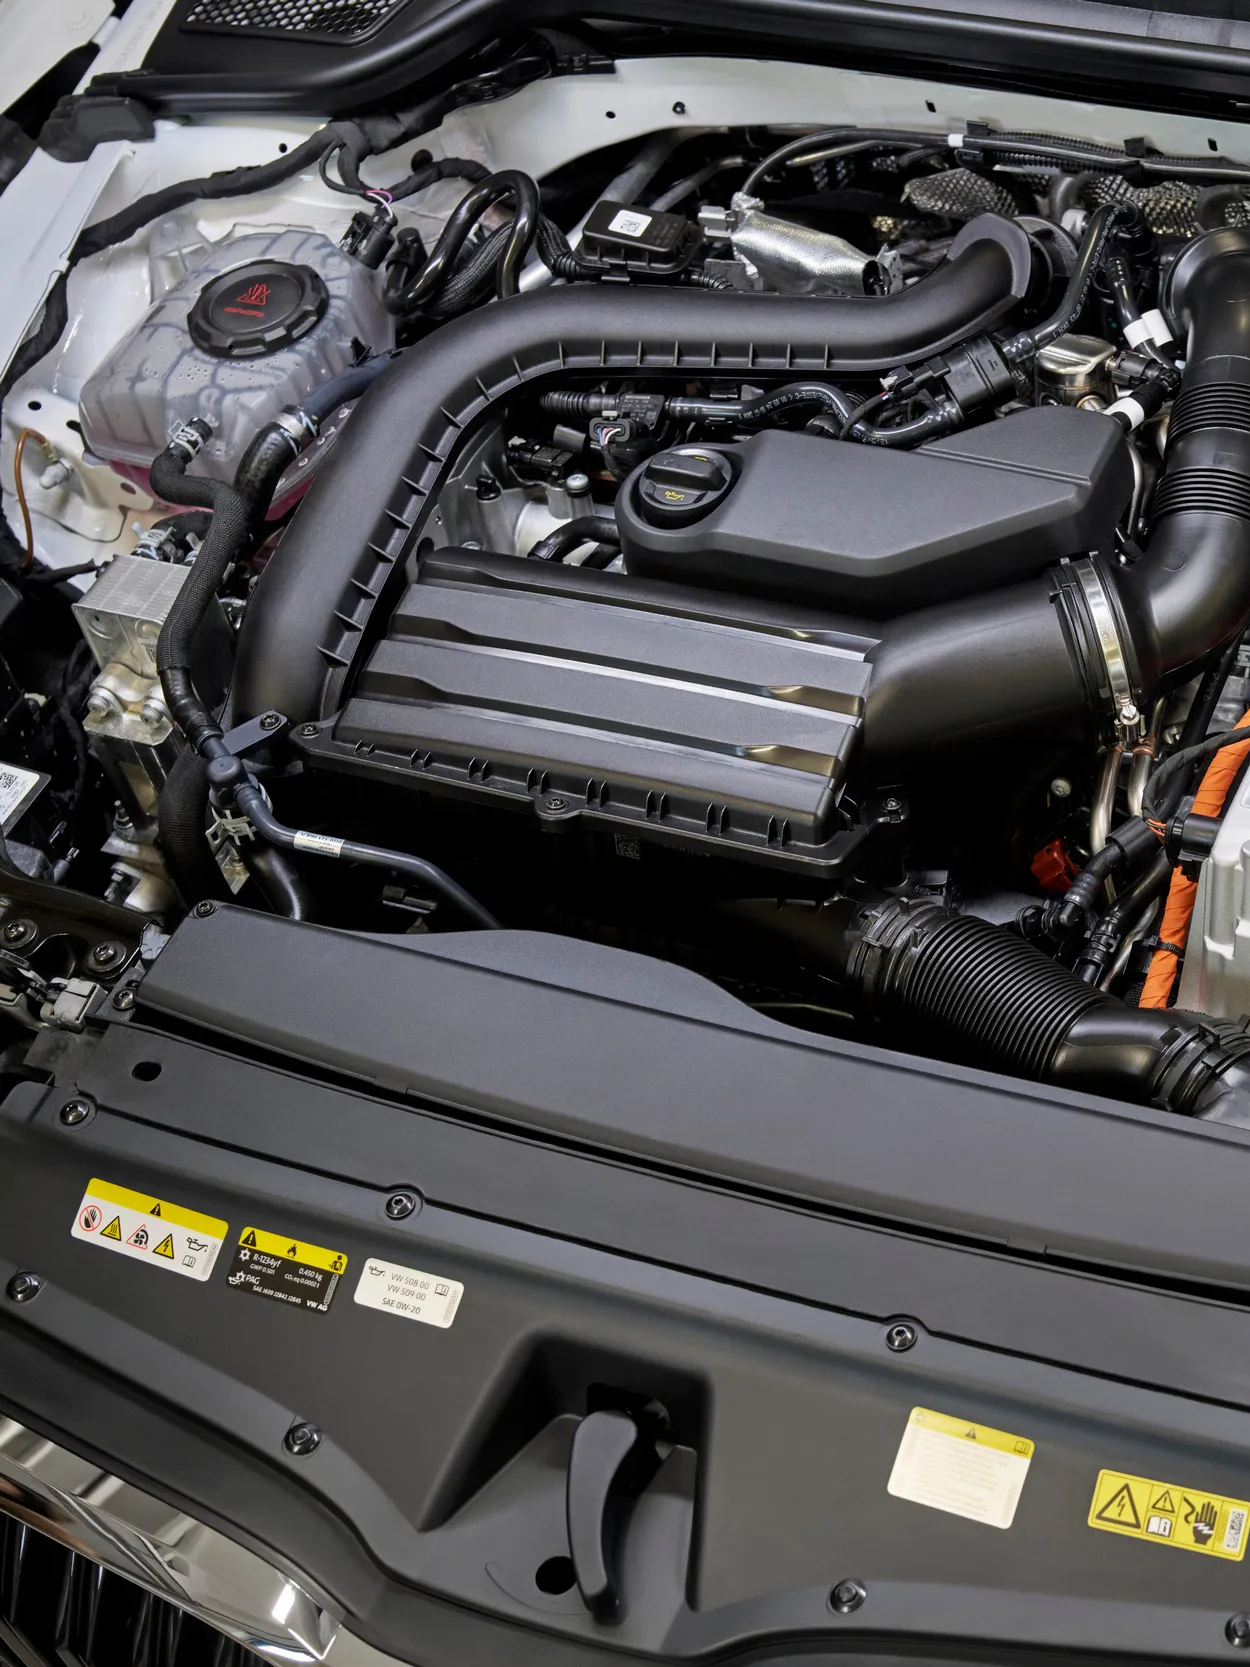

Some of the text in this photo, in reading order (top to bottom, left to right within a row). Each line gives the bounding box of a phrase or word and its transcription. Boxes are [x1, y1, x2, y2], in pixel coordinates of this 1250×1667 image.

[253, 1254, 282, 1268] R-1234yf
[250, 1264, 275, 1275] GWP 0.501
[299, 1268, 323, 1281] 0.450 kg
[246, 1274, 260, 1284] PAG
[391, 1273, 430, 1290] VW 508 00
[388, 1284, 426, 1301] VW 509 00
[306, 1300, 328, 1312] VW AG
[382, 1297, 421, 1314] SAE 0W-20
